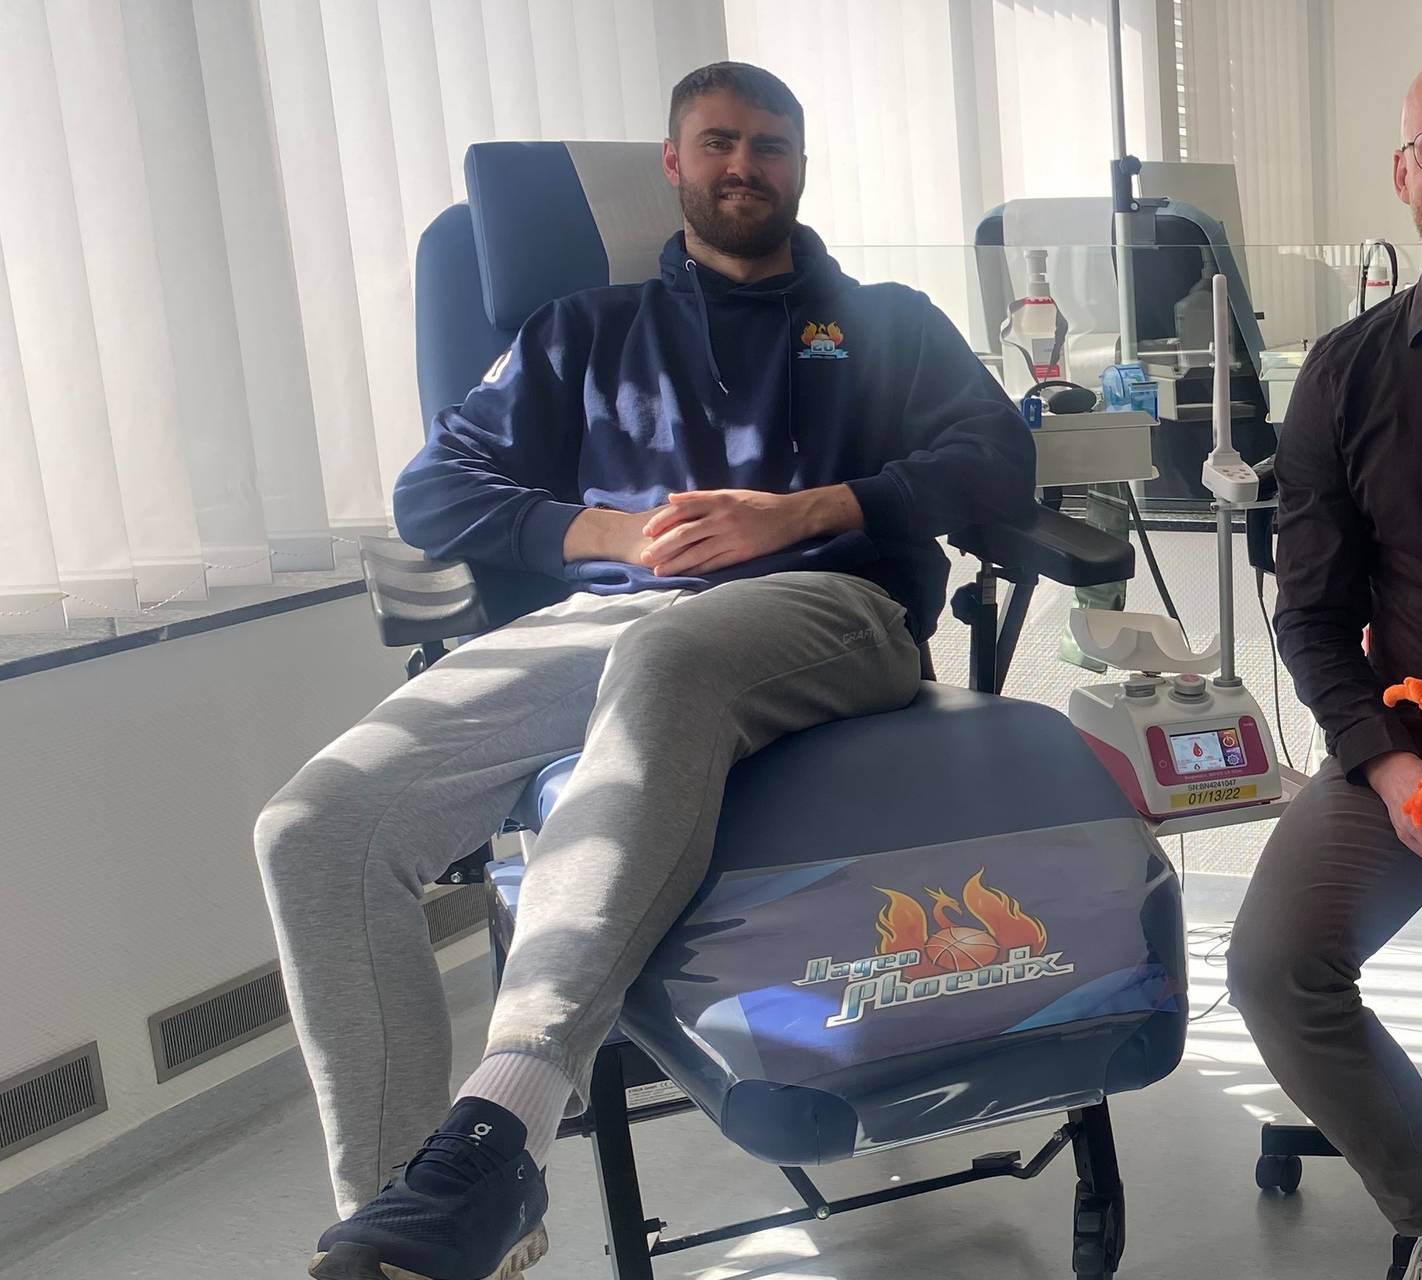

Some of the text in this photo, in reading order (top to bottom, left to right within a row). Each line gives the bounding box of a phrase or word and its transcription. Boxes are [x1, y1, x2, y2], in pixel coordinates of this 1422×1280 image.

[1188, 788, 1240, 806] 01/13/22
[792, 949, 921, 986] Hagen
[826, 945, 1074, 1028] Phoenix
